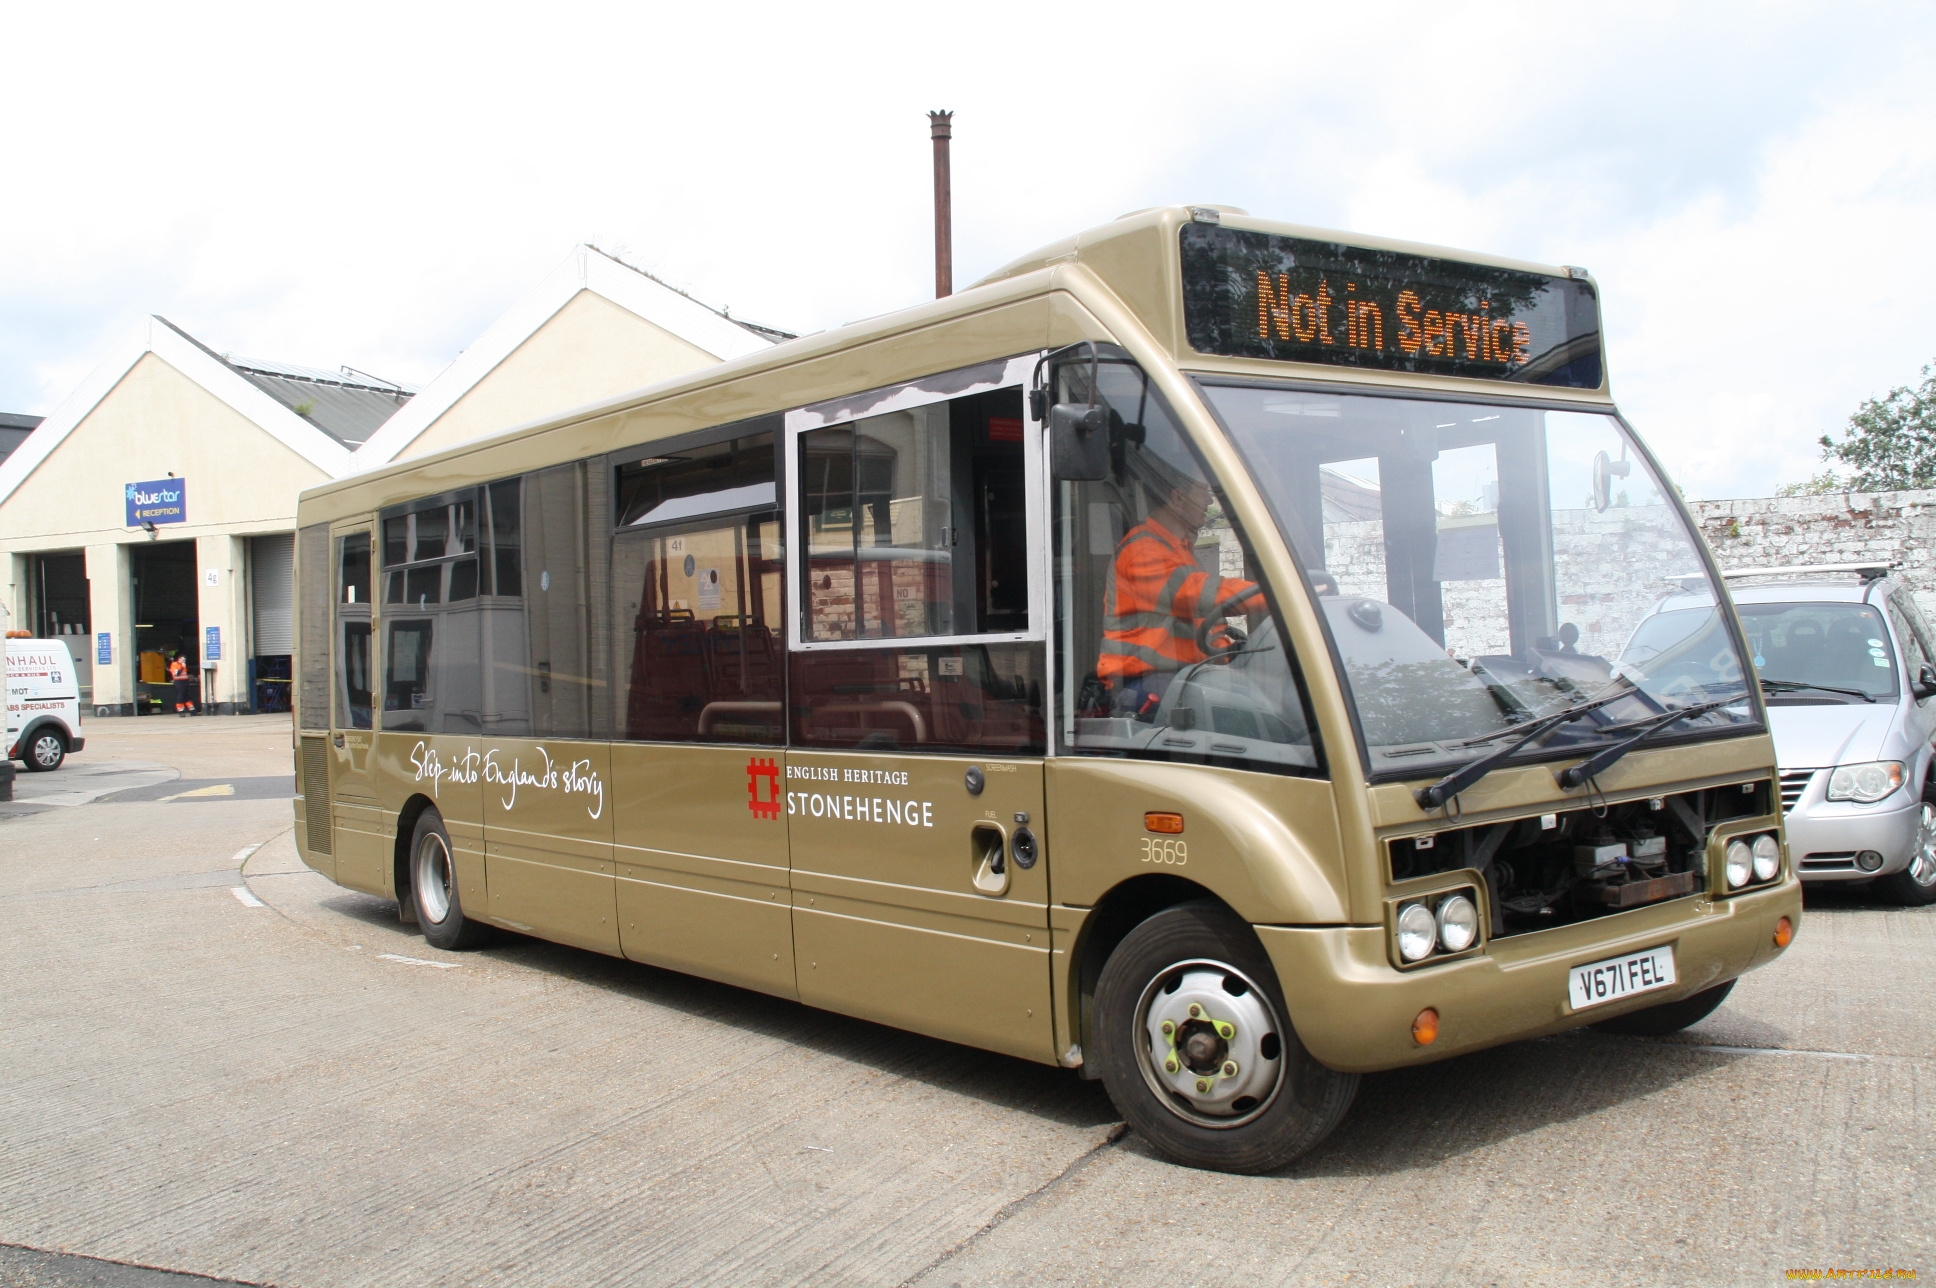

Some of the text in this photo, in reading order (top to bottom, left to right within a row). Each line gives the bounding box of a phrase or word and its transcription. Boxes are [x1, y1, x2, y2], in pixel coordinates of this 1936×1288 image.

[1257, 270, 1531, 364] Not in Service
[134, 488, 181, 505] bluestar
[142, 507, 180, 517] RECEPTION
[671, 540, 683, 551] 4f
[207, 573, 217, 584] 4g
[11, 687, 29, 696] MOT
[21, 702, 65, 711] SPECIALISTS
[985, 763, 1017, 772] SCREENWASH
[410, 740, 604, 820] Step into England's story
[786, 765, 909, 785] ENGLISH HERITAGE
[787, 791, 934, 827] STONEHENGE
[984, 810, 997, 819] FUEL
[1140, 837, 1188, 866] 3669
[1580, 955, 1664, 1000] V671 FEL
